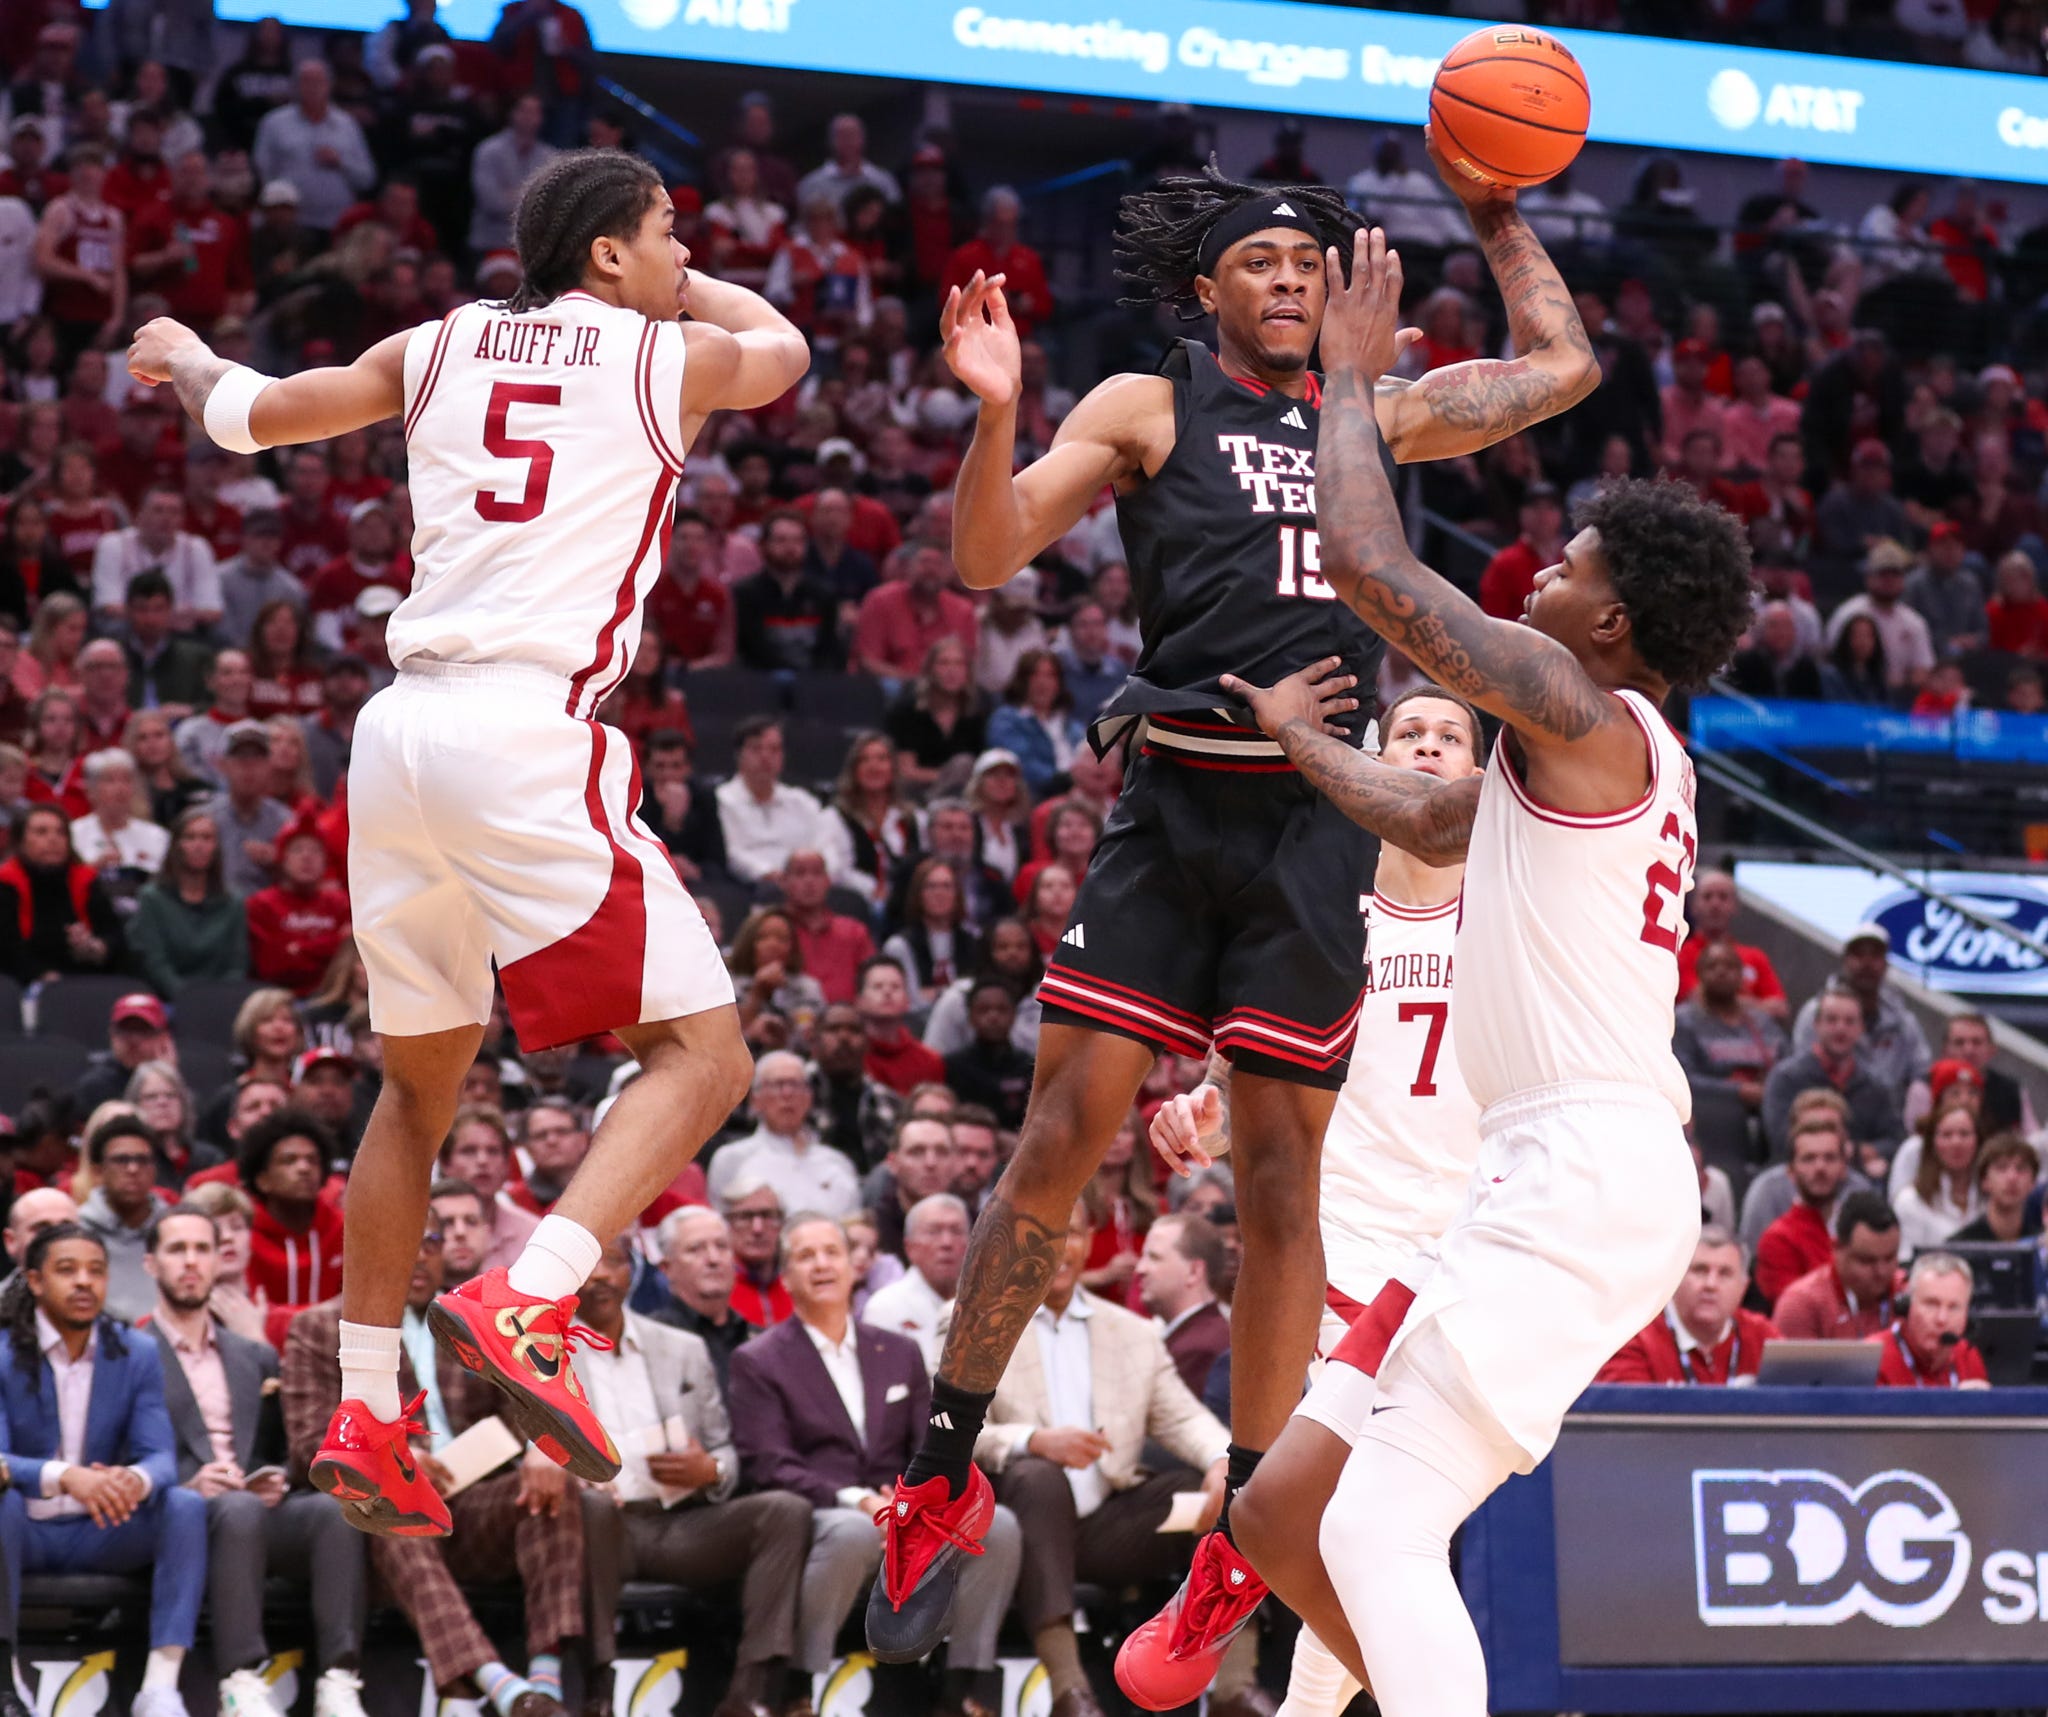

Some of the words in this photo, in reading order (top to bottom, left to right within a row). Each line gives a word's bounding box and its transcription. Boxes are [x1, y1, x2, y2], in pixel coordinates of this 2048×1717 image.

[953, 6, 1169, 73] Connecting
[1177, 27, 1349, 87] Changes
[1764, 83, 1864, 133] AT&T
[474, 319, 562, 365] ACUFF
[564, 326, 600, 366] JR.
[474, 381, 562, 523] 5
[1276, 525, 1337, 600] 15
[1906, 892, 2048, 969] Ford
[1398, 1002, 1448, 1096] 7
[1692, 1468, 1972, 1627] BDG
